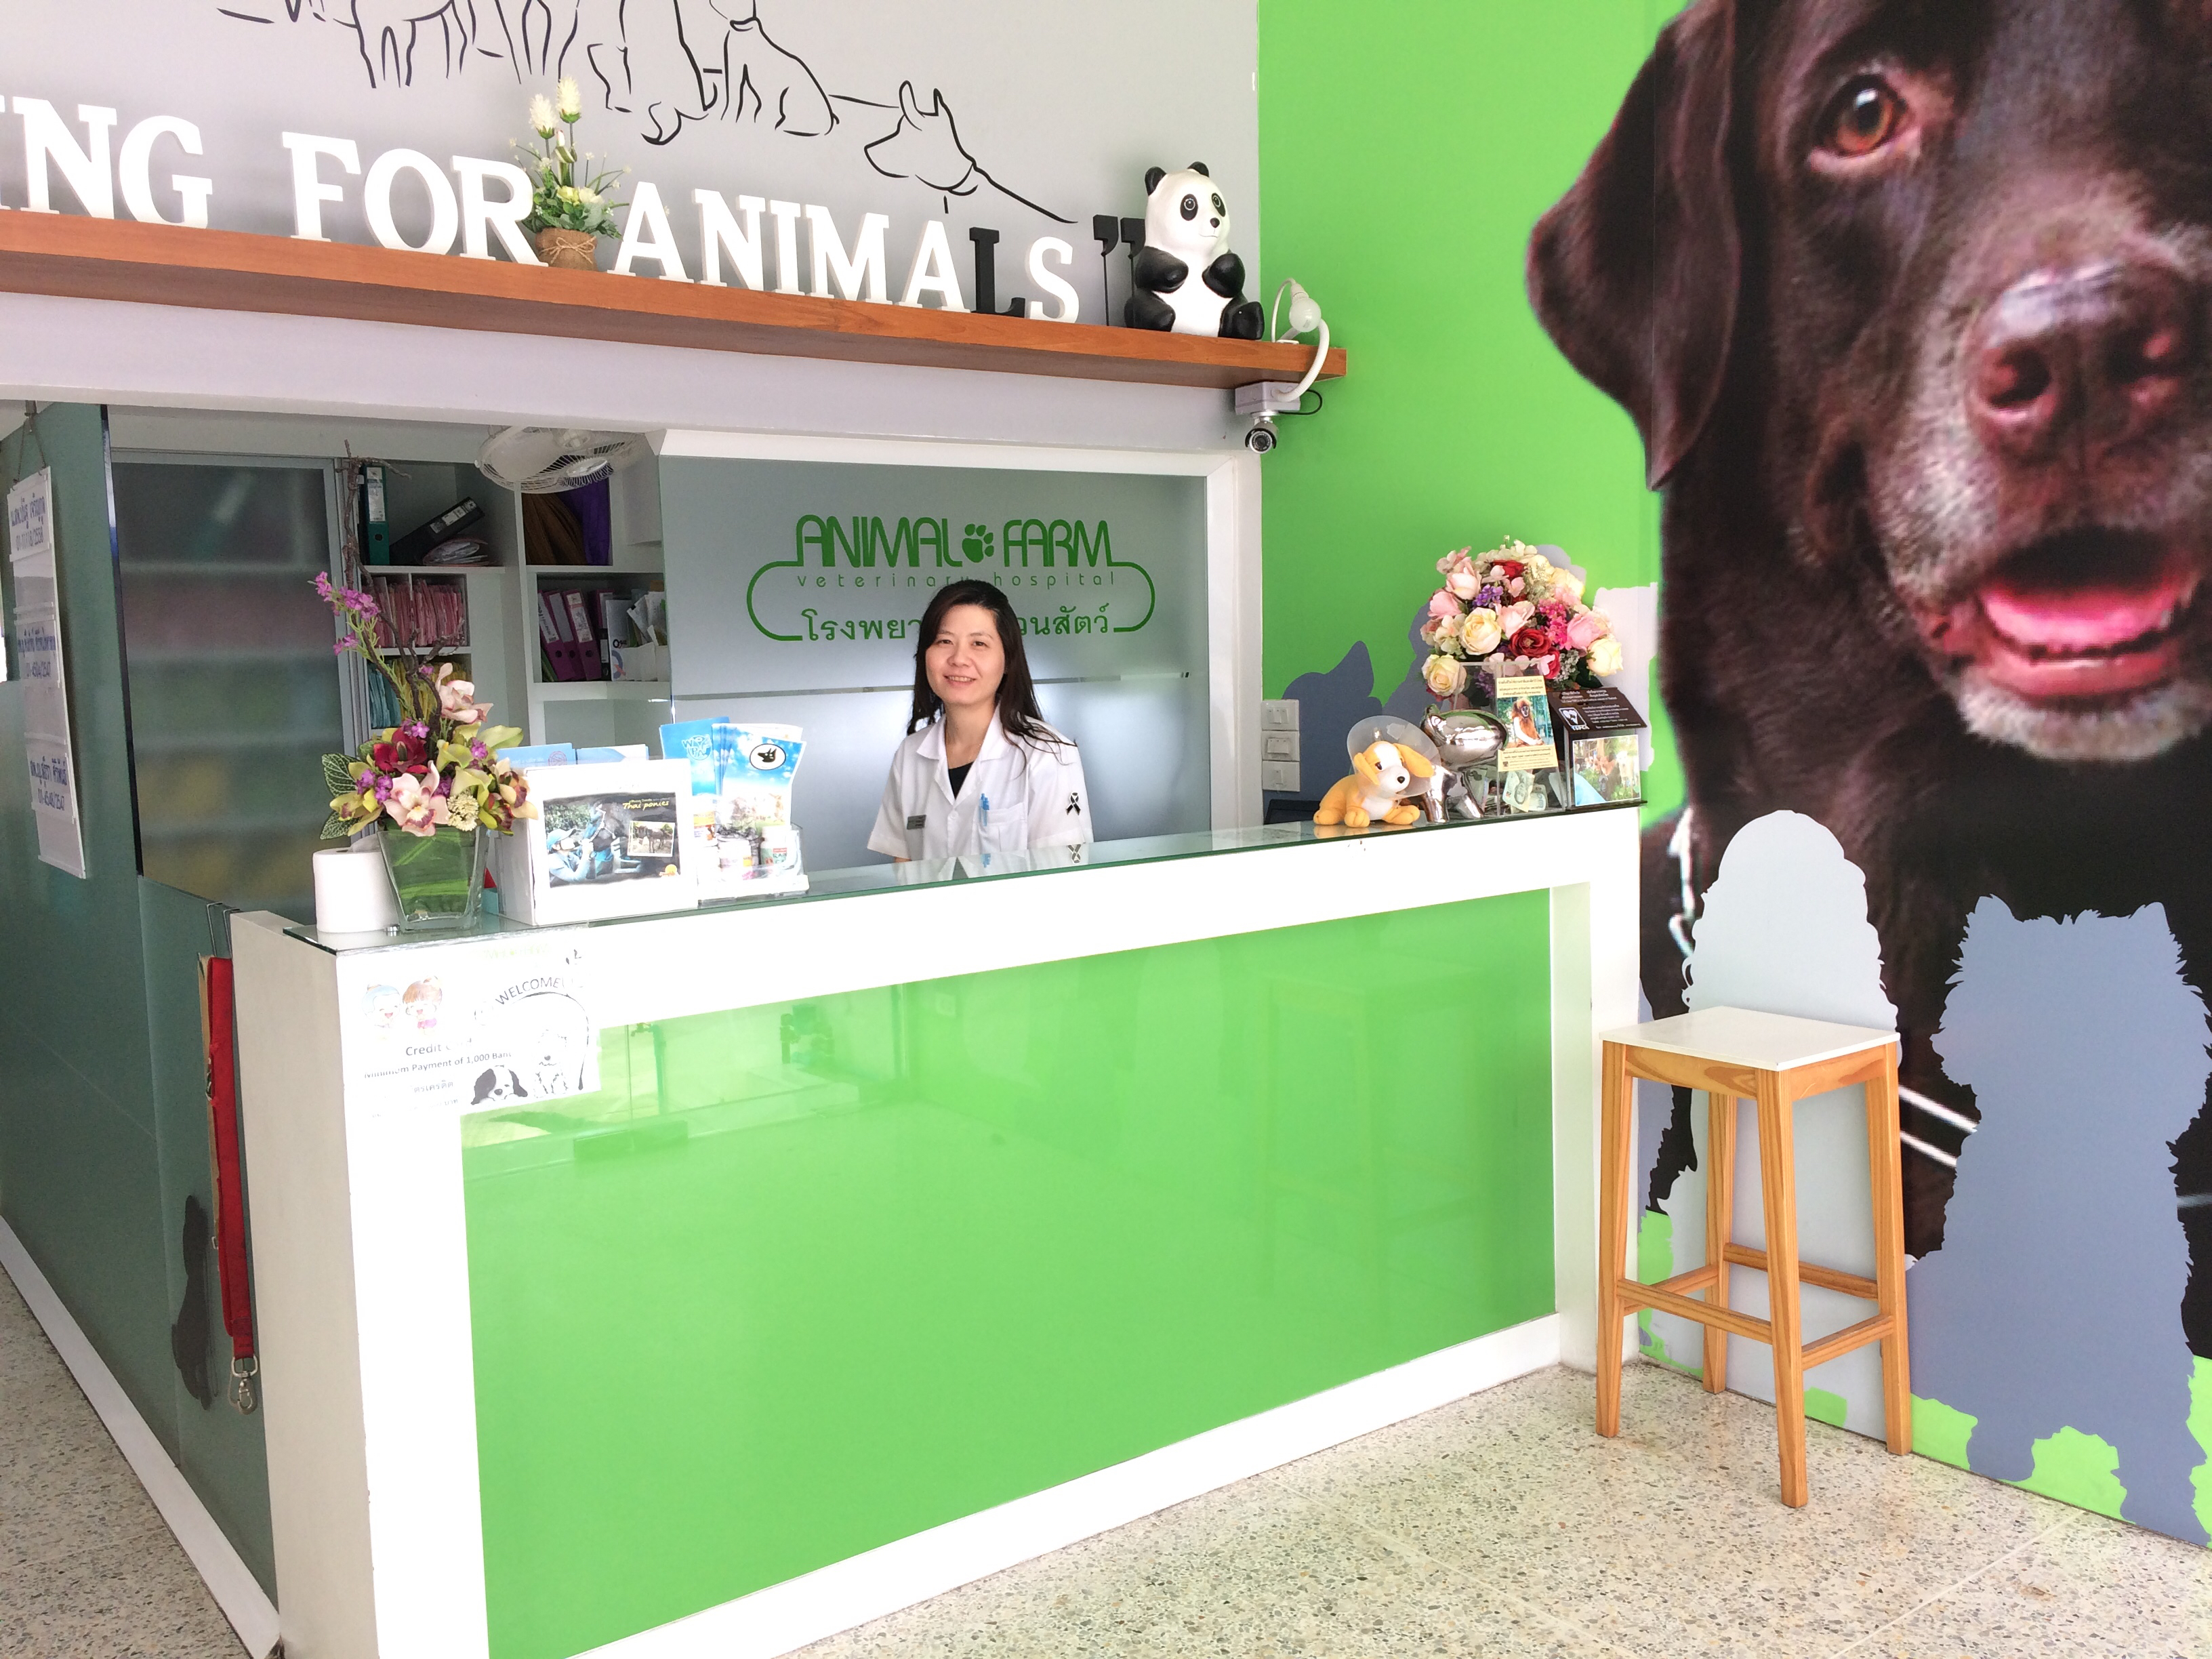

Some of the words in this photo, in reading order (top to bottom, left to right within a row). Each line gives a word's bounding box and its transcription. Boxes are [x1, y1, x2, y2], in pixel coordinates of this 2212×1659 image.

[0, 95, 212, 229] NG
[281, 131, 550, 267] FOR
[796, 514, 963, 568] ANIMAL
[1003, 518, 1112, 568] FARM
[994, 571, 1114, 590] hospital
[405, 1043, 442, 1057] Credit
[411, 1059, 452, 1071] Payment
[454, 1057, 464, 1065] of
[466, 1053, 490, 1065] 1,000
